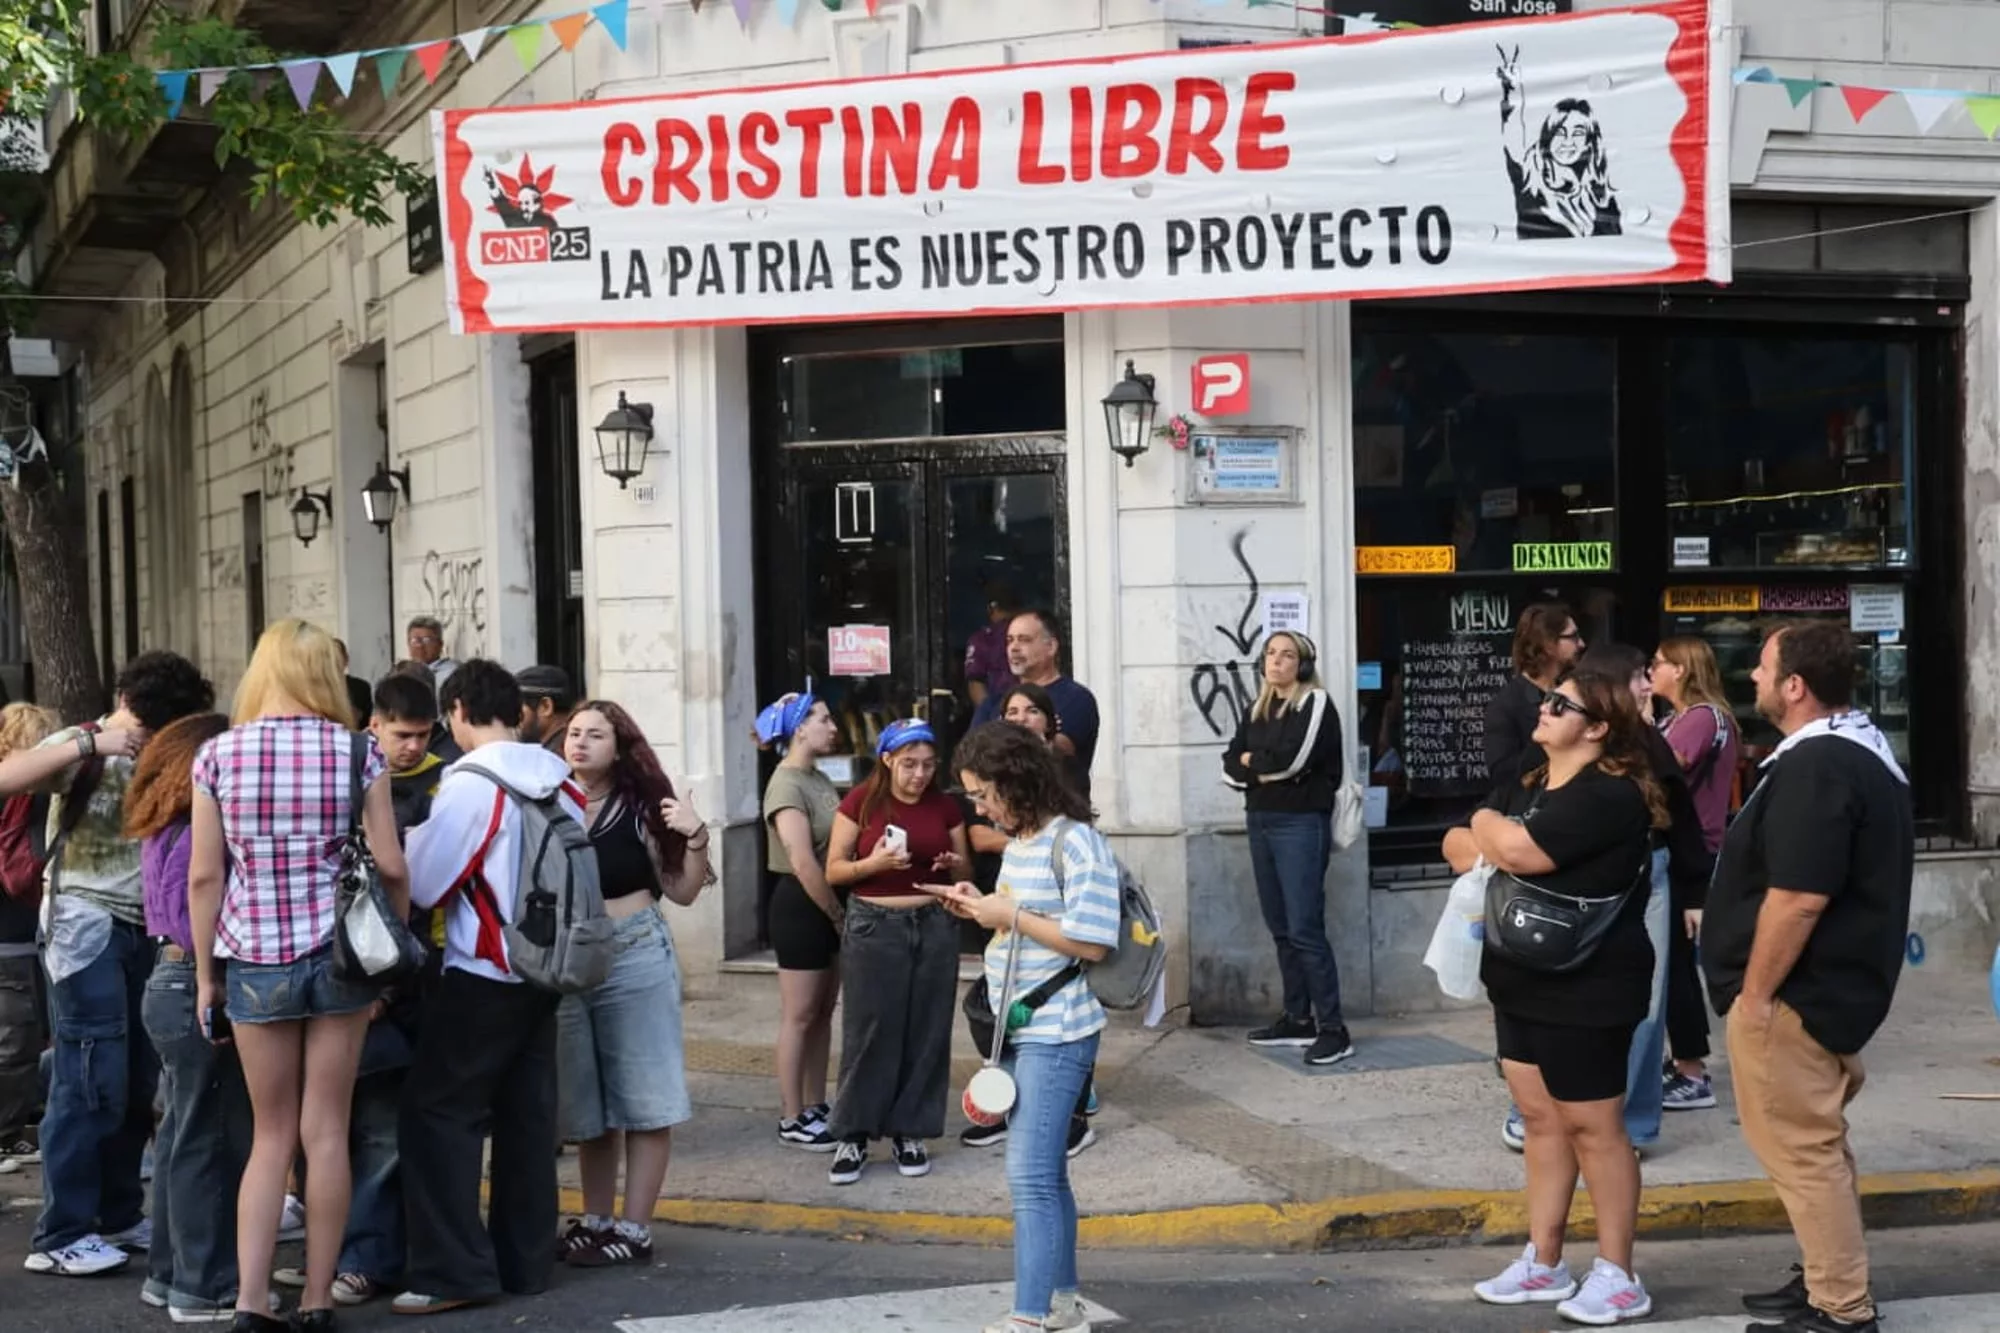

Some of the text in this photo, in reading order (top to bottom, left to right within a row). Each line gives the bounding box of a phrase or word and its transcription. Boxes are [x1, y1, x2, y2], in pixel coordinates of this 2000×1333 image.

[600, 71, 1296, 207] CRISTINA LIBRE
[484, 229, 588, 263] CNP 25
[601, 204, 1452, 300] LA PATRIA ES NUESTRO PROYECTO
[1362, 550, 1448, 570] POSTRES
[1516, 543, 1610, 570] DESAYUNOS
[1451, 596, 1509, 631] MENU
[833, 631, 857, 652] 10
[1466, 657, 1479, 671] DE
[1488, 654, 1512, 669] PIZZ
[1413, 750, 1456, 764] PASTAS
